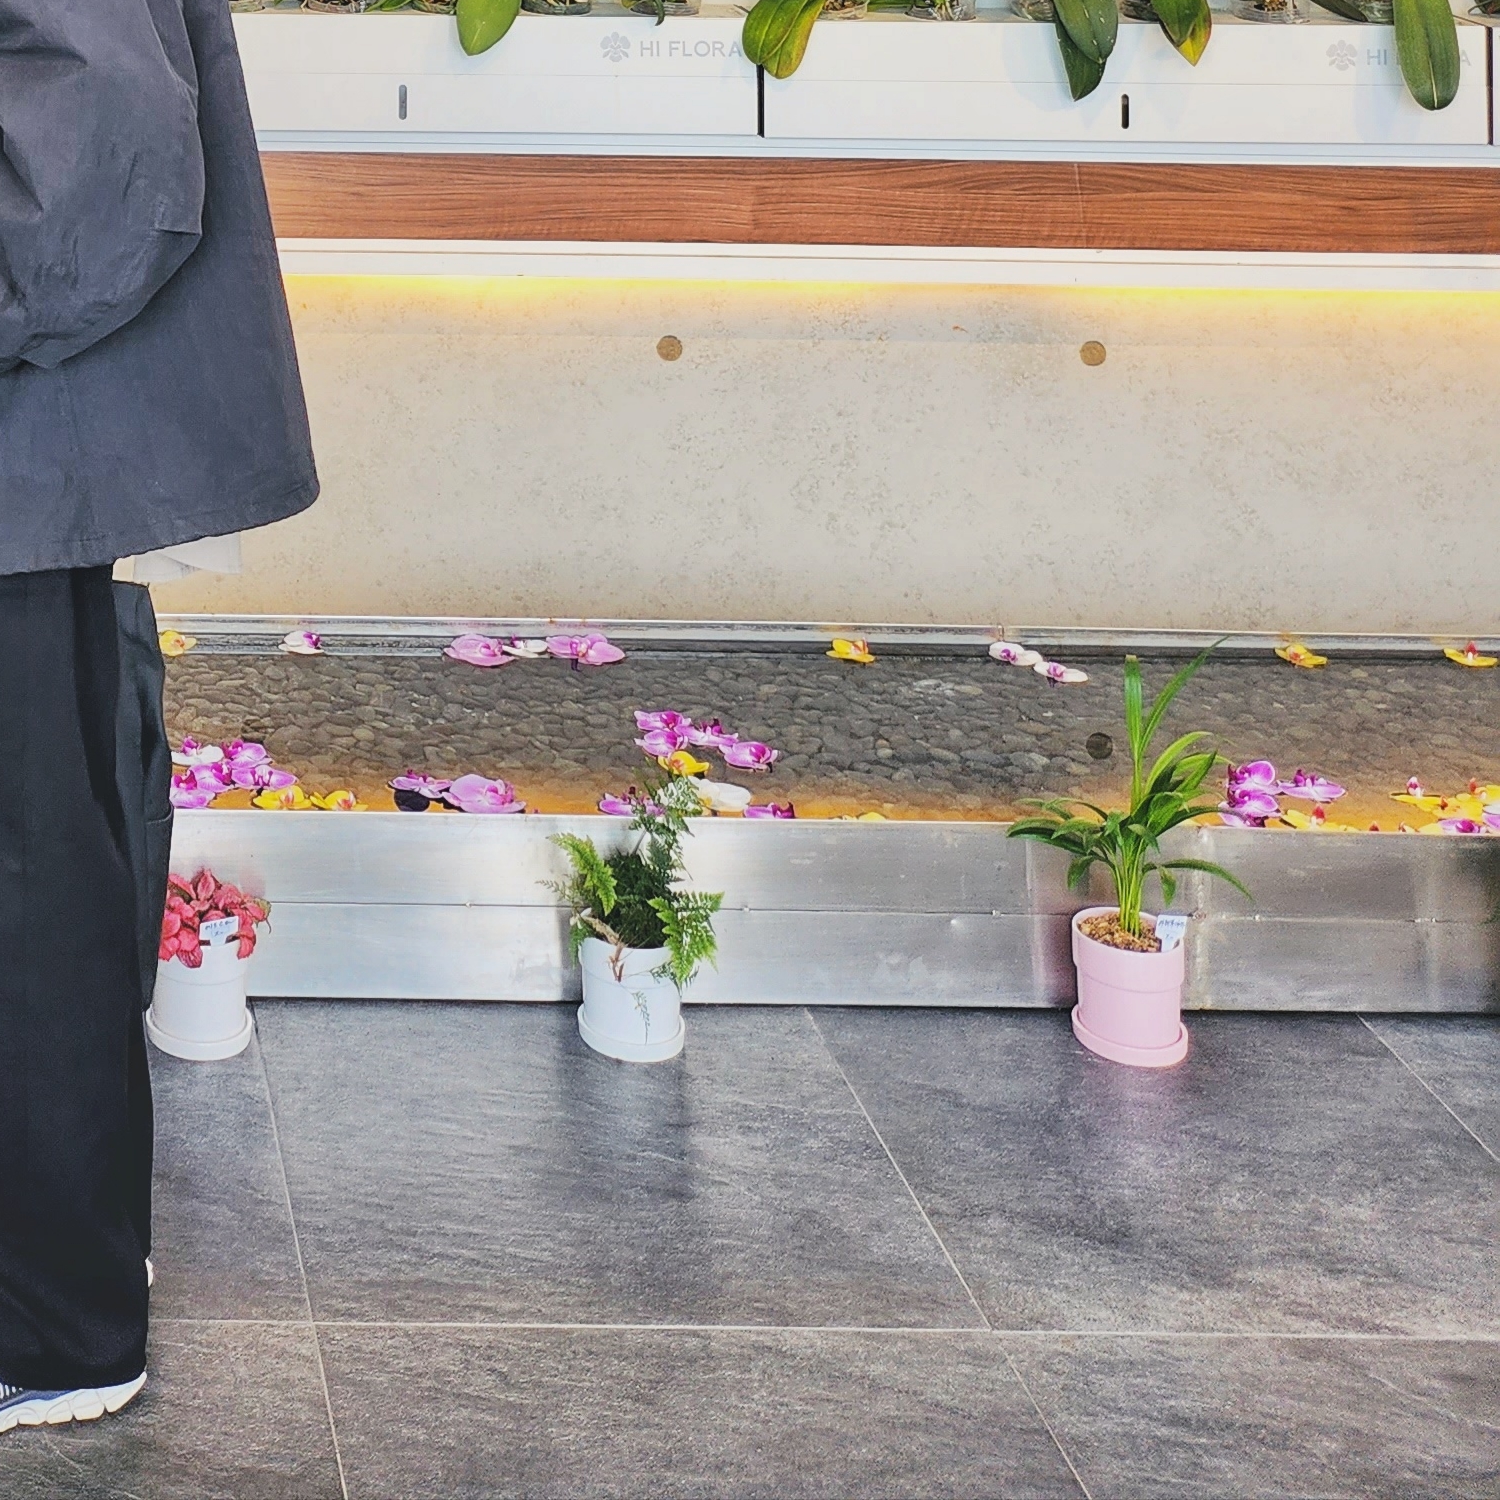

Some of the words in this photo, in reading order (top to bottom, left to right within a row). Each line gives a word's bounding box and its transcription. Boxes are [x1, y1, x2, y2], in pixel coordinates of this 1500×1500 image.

[640, 41, 660, 57] HI
[668, 40, 742, 58] FLORA
[1367, 50, 1387, 66] HI
